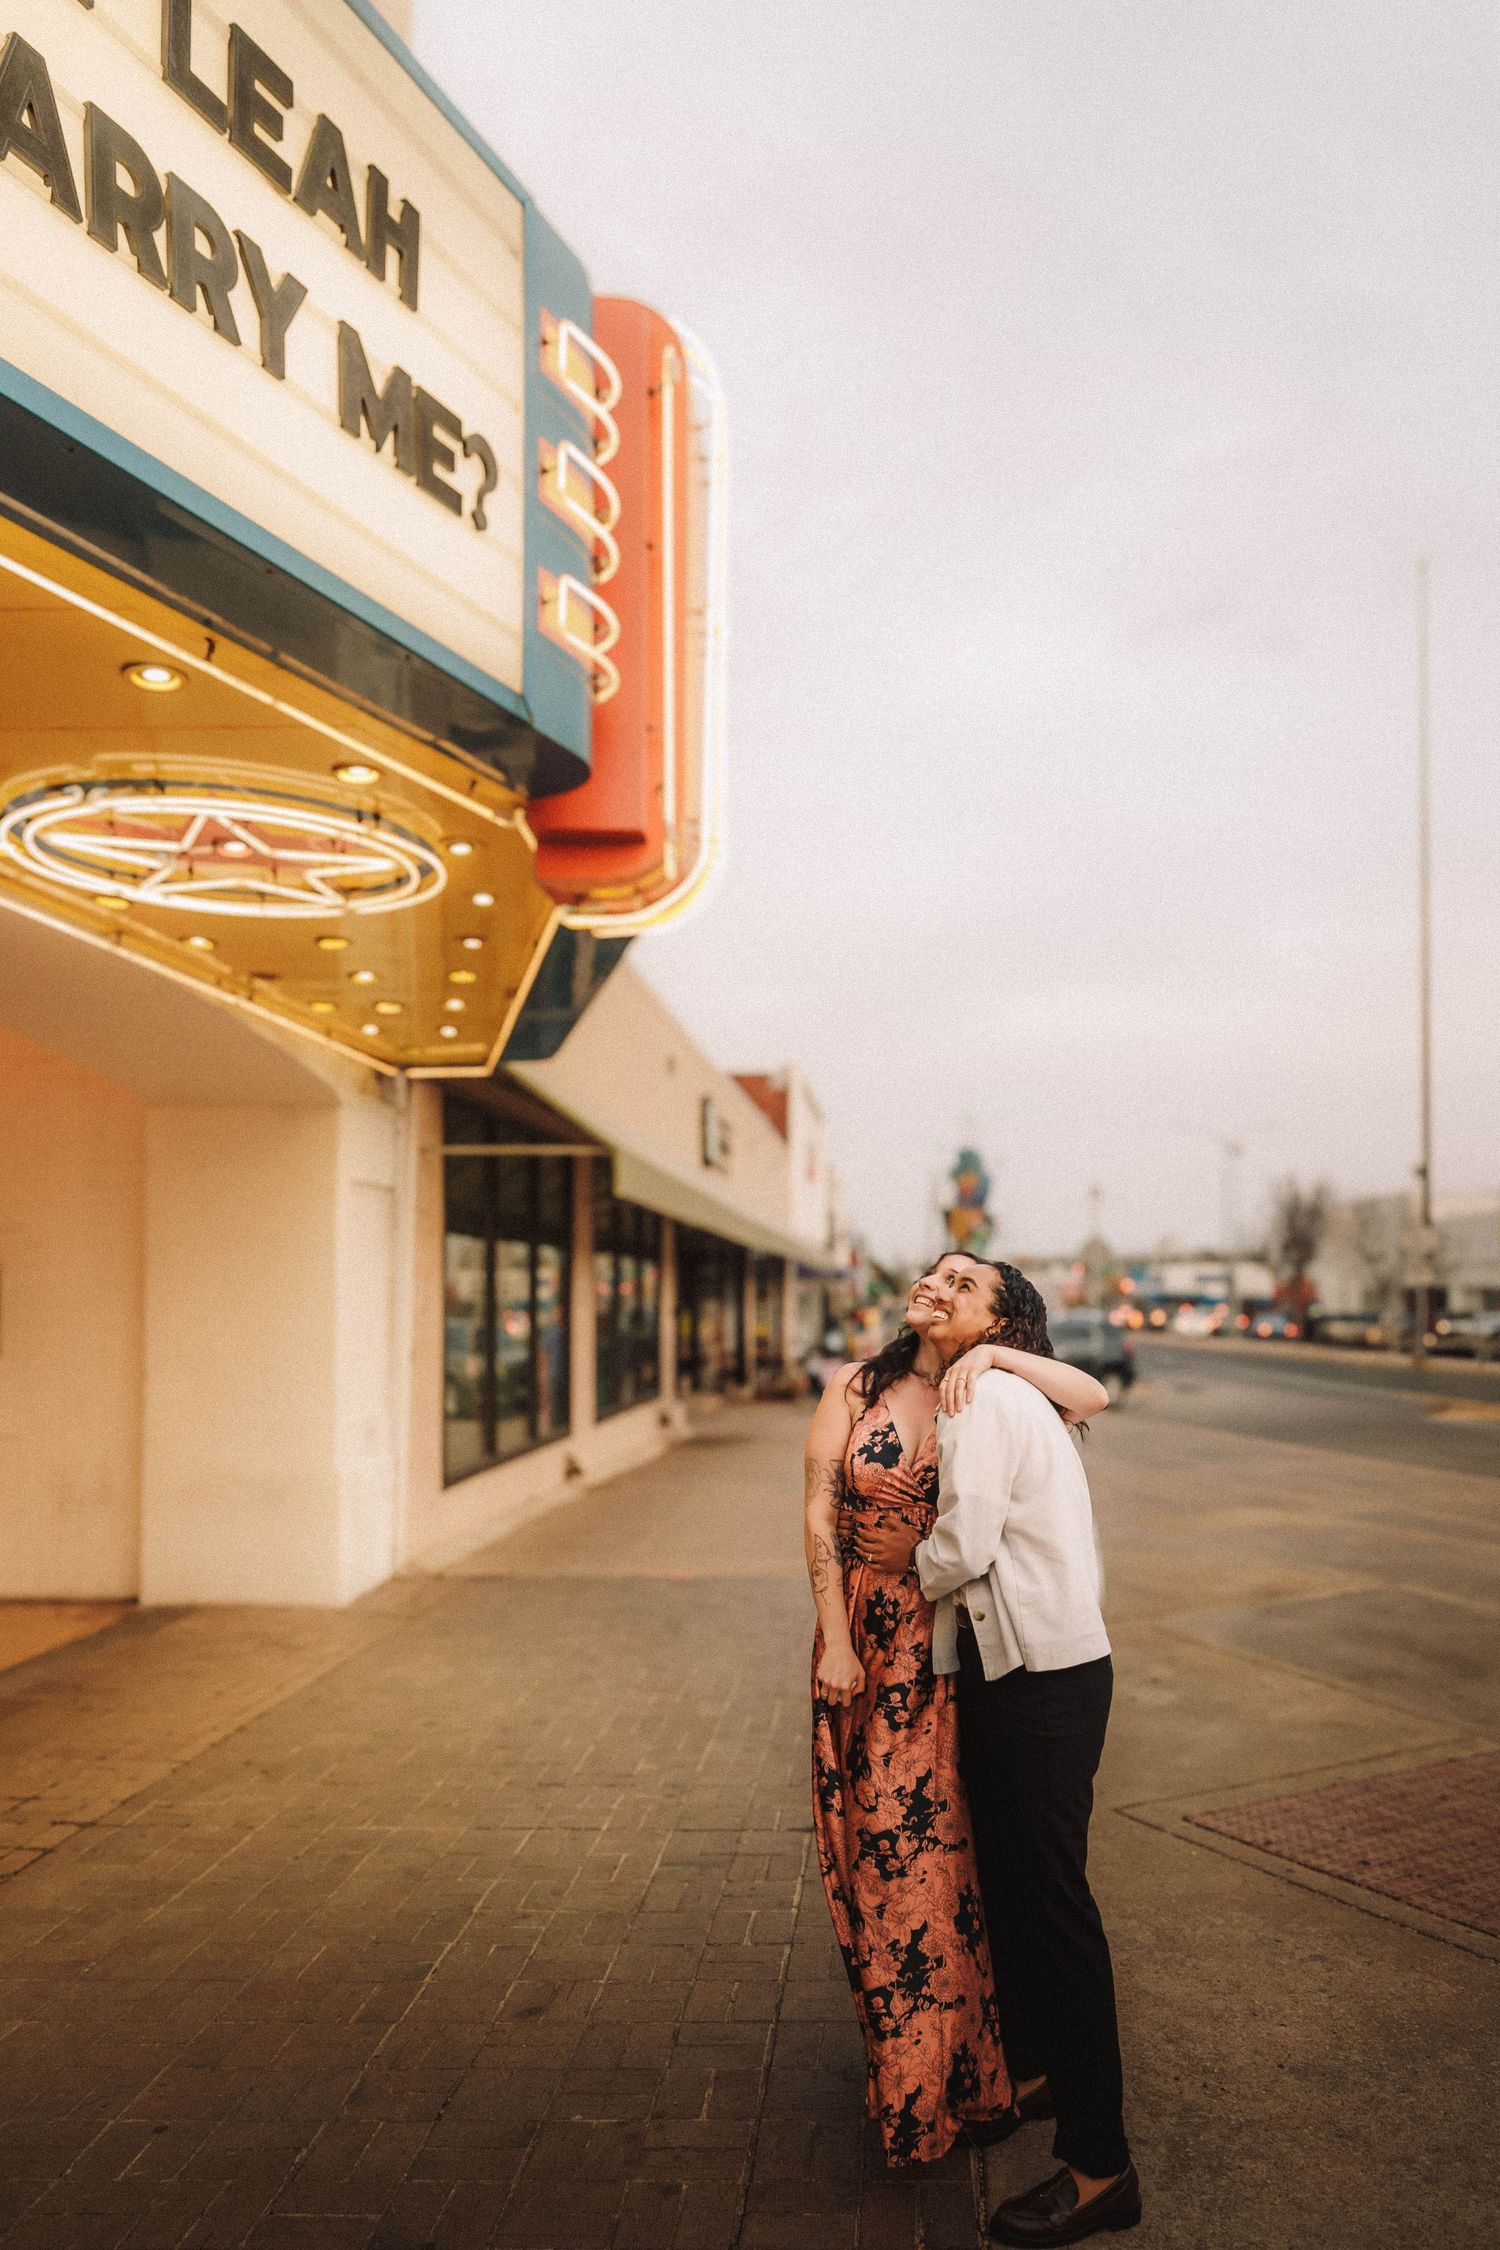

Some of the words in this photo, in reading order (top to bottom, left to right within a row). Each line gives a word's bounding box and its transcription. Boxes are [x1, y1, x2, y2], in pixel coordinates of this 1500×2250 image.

[0, 31, 308, 381] ARRY
[338, 319, 498, 531] ME?
[161, 0, 420, 312] LEAH
